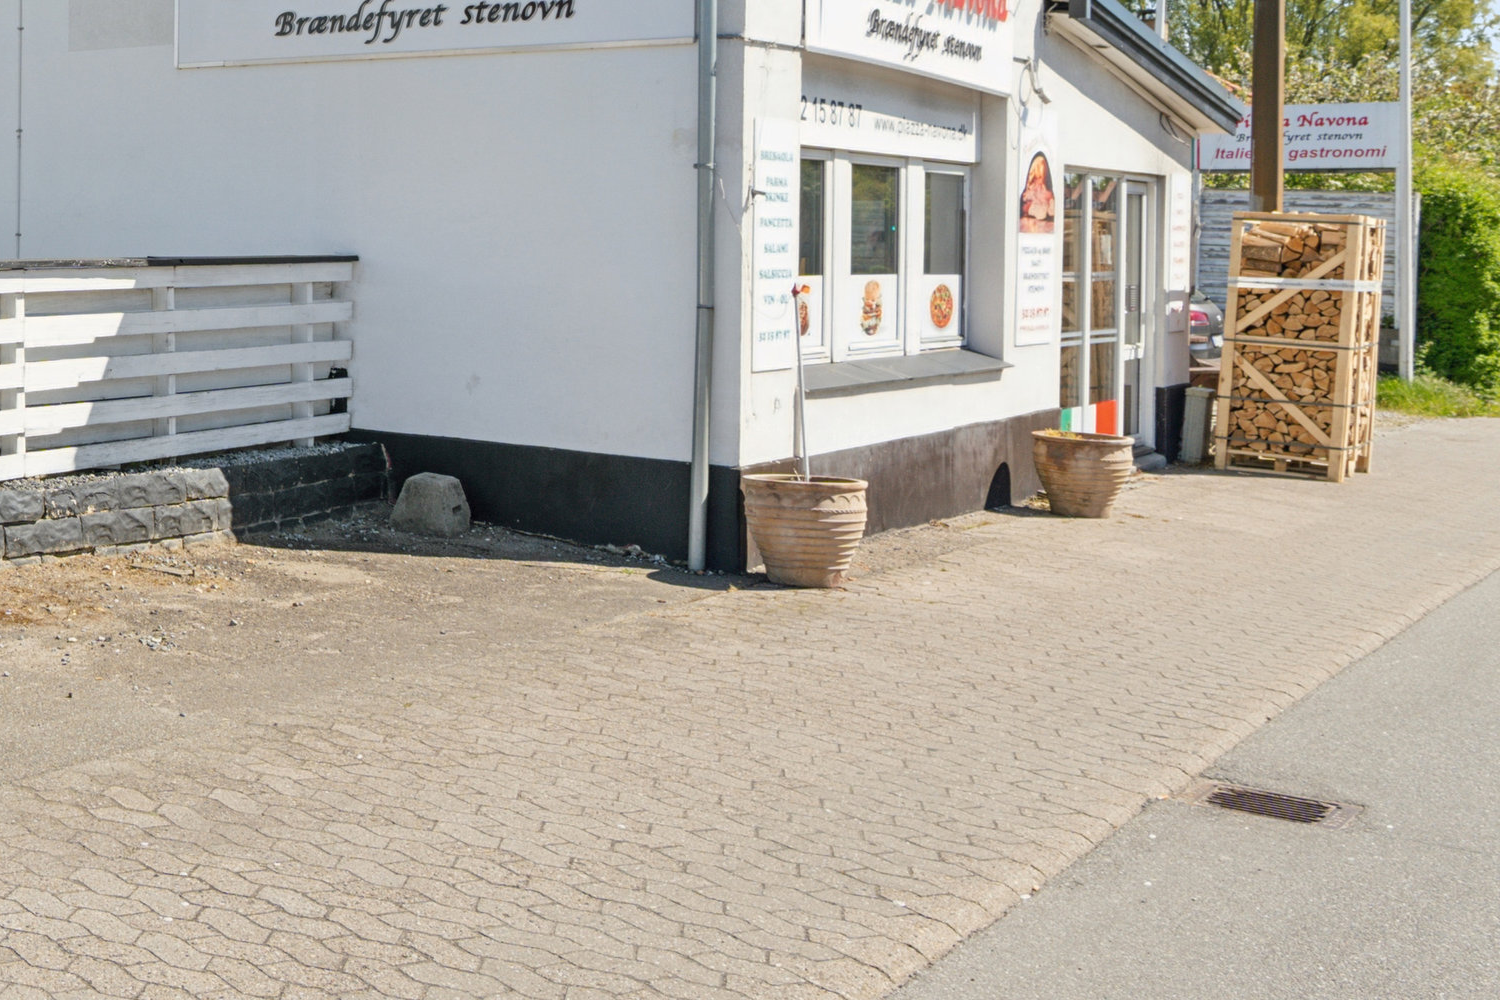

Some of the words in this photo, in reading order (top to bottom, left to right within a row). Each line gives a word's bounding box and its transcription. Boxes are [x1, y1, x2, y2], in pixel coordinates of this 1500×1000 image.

[868, 9, 940, 60] Brændefyret
[943, 35, 982, 62] stenovn
[812, 97, 826, 124] 15
[830, 100, 844, 126] 87
[848, 103, 863, 129] 87
[1297, 112, 1369, 127] Navona
[1317, 133, 1363, 141] stenovn
[1288, 146, 1387, 161] gastronomi
